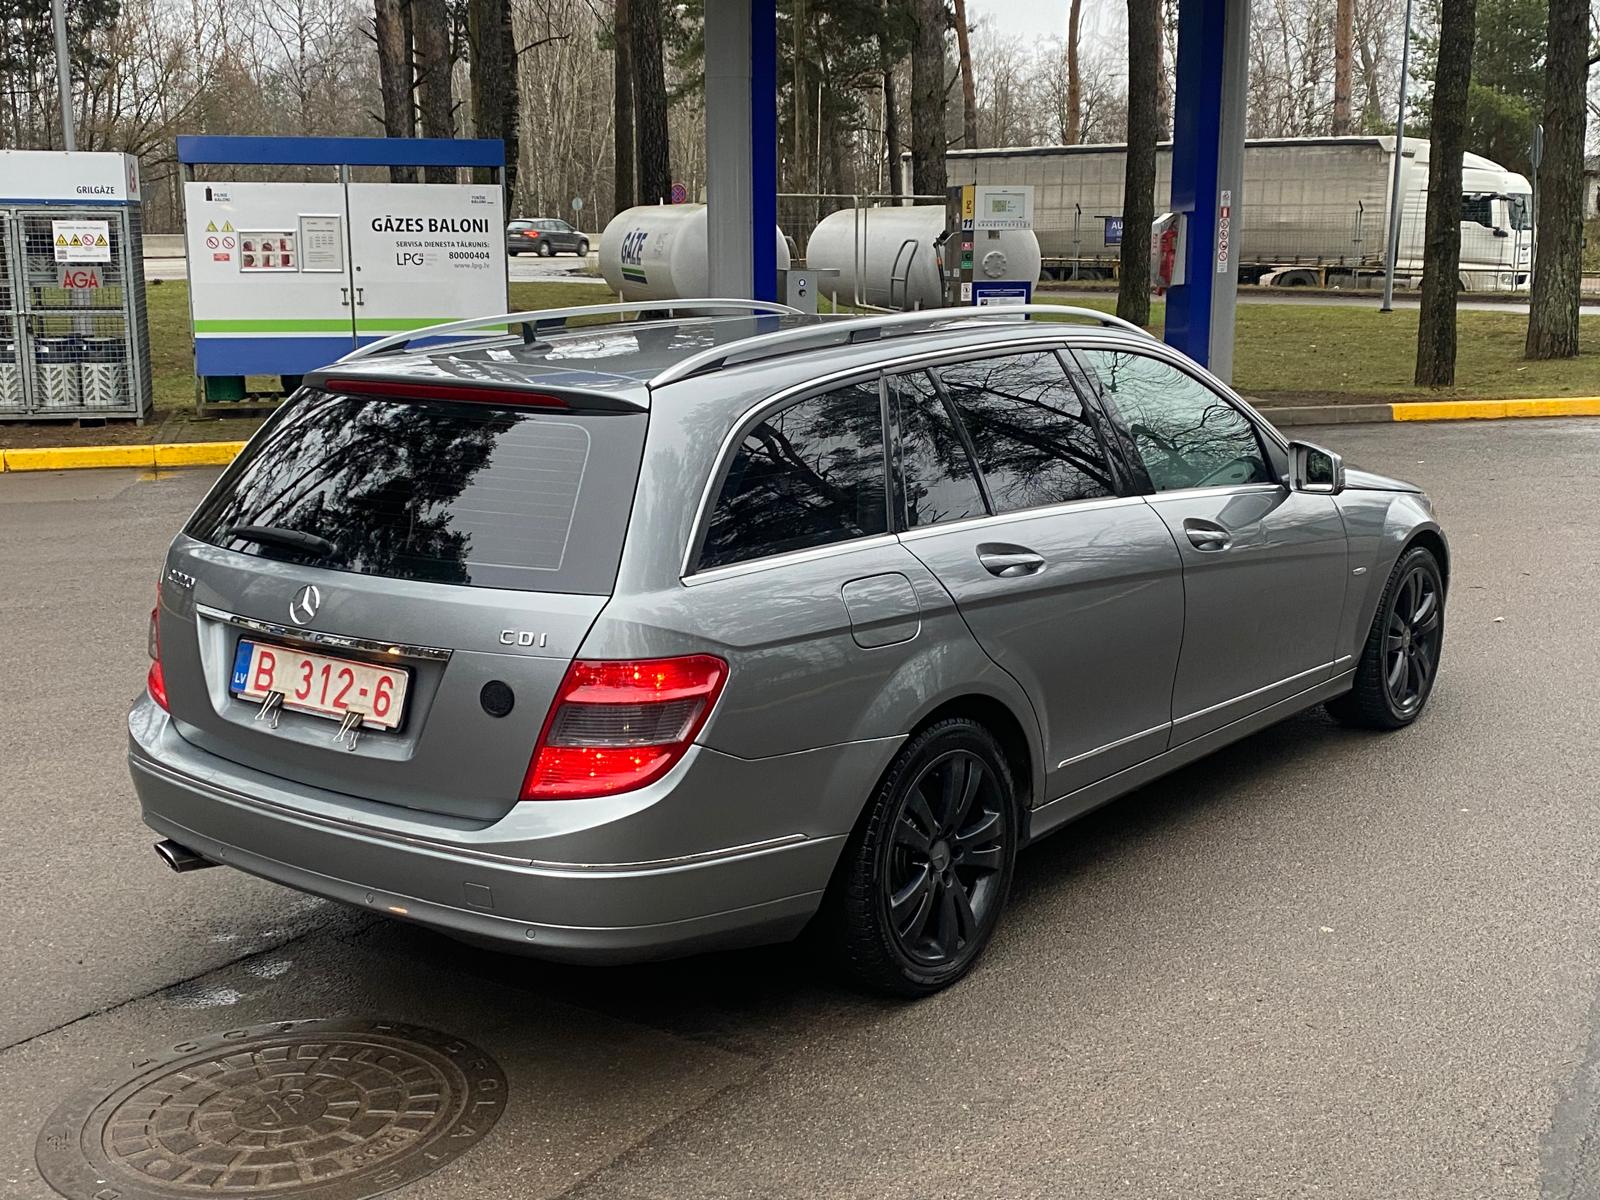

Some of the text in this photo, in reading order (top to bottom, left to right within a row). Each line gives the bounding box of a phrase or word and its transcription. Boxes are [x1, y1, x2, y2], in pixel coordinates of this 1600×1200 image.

[371, 215, 489, 233] GĀZES BALONI
[963, 218, 973, 229] 11
[396, 252, 424, 266] LPG
[448, 251, 490, 260] 80000404
[63, 269, 99, 290] AGA
[499, 629, 547, 648] CDI
[234, 671, 247, 684] LV
[254, 651, 394, 717] B 312-6
